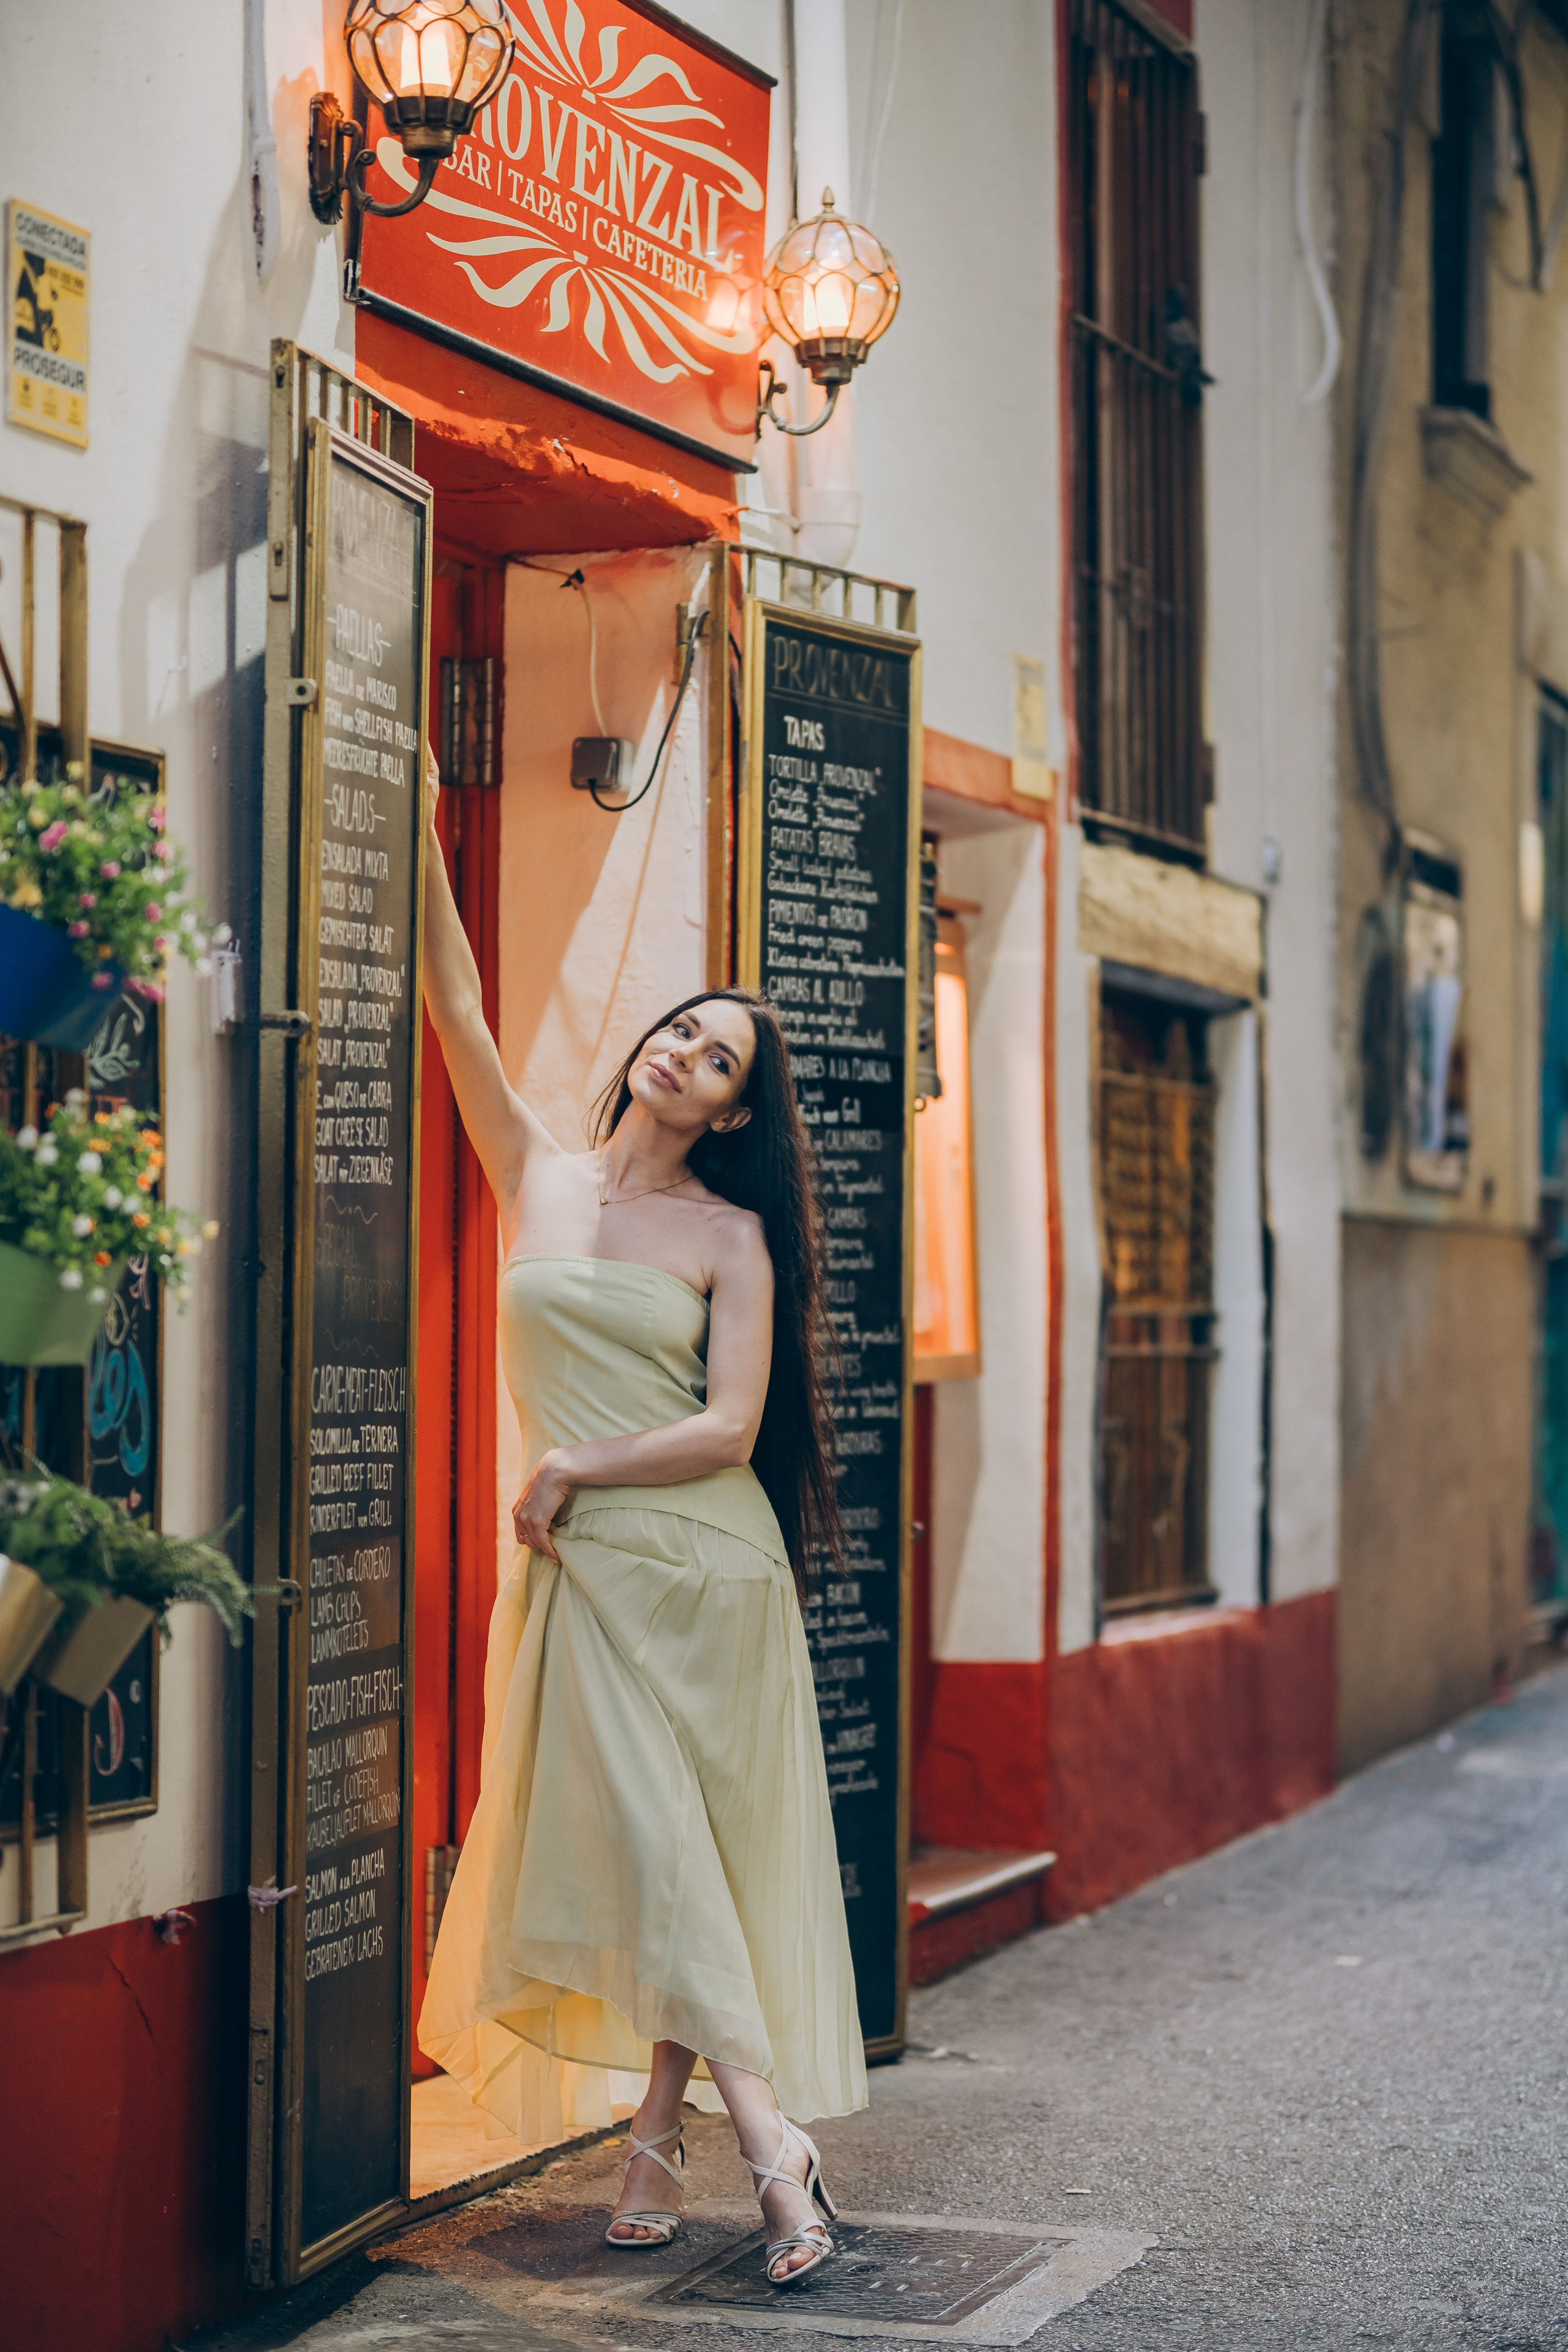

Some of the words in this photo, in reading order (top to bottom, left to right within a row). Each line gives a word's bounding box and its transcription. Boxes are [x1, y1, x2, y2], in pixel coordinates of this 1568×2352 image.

[462, 56, 734, 274] ROVENZAL
[442, 140, 492, 190] BAR
[508, 168, 578, 234] TAPAS
[592, 216, 708, 301] CAFETERIA
[14, 345, 86, 390] PROSEGUR
[325, 659, 354, 696] PAELLA
[367, 676, 396, 711] MARISCO
[325, 696, 342, 729] FISH
[355, 708, 393, 744] SHELLFISH
[396, 722, 417, 753] PAELLA
[783, 715, 826, 752] TAPAS
[381, 753, 405, 787] PAELLA
[768, 754, 817, 783] TORTILLA
[771, 826, 814, 854] PATATAS
[322, 840, 361, 875] ENSALADA
[365, 850, 388, 881] MIXTA
[321, 879, 345, 910] MIXED
[349, 884, 373, 914] SALAD
[319, 916, 368, 949] GEMISCHTER
[369, 925, 394, 954] SALAT
[319, 957, 357, 989] ENSALADA
[767, 976, 810, 1003] GAMBAS
[318, 998, 343, 1028] SALAD
[317, 1038, 342, 1066] SALAT
[335, 1081, 359, 1114] QUESO
[368, 1081, 392, 1112] CABRA
[315, 1117, 335, 1147] GOAT
[335, 1117, 363, 1147] CHEESE
[366, 1117, 388, 1147] SALAD
[314, 1154, 339, 1183] SALAT
[310, 1428, 352, 1456] SOLOMILLO
[360, 1425, 398, 1453] TERNERA
[309, 1464, 342, 1496] GRILLED
[343, 1463, 364, 1492] BEEF
[368, 1463, 394, 1491] FILLET
[310, 1502, 356, 1536] RINDERFILET
[369, 1498, 391, 1526] GRILL
[310, 1555, 345, 1588] CHULETAS
[347, 1567, 353, 1581] DE
[354, 1547, 391, 1581] CORDERO
[311, 1593, 334, 1627] LAMB
[336, 1591, 361, 1622] CHOPS
[307, 1739, 342, 1779] BACALAO
[345, 1726, 387, 1766] MALLORQUIN
[307, 1781, 332, 1813] FILLET
[334, 1789, 341, 1807] OF
[344, 1765, 379, 1804] CODEFISH
[306, 1868, 337, 1903] SALMON
[352, 1848, 385, 1885] PLANCHA
[305, 1901, 341, 1942] GRILLED
[344, 1889, 376, 1927] SALMON
[305, 1935, 354, 1981] GEBRATENER
[358, 1926, 383, 1961] LACHS
